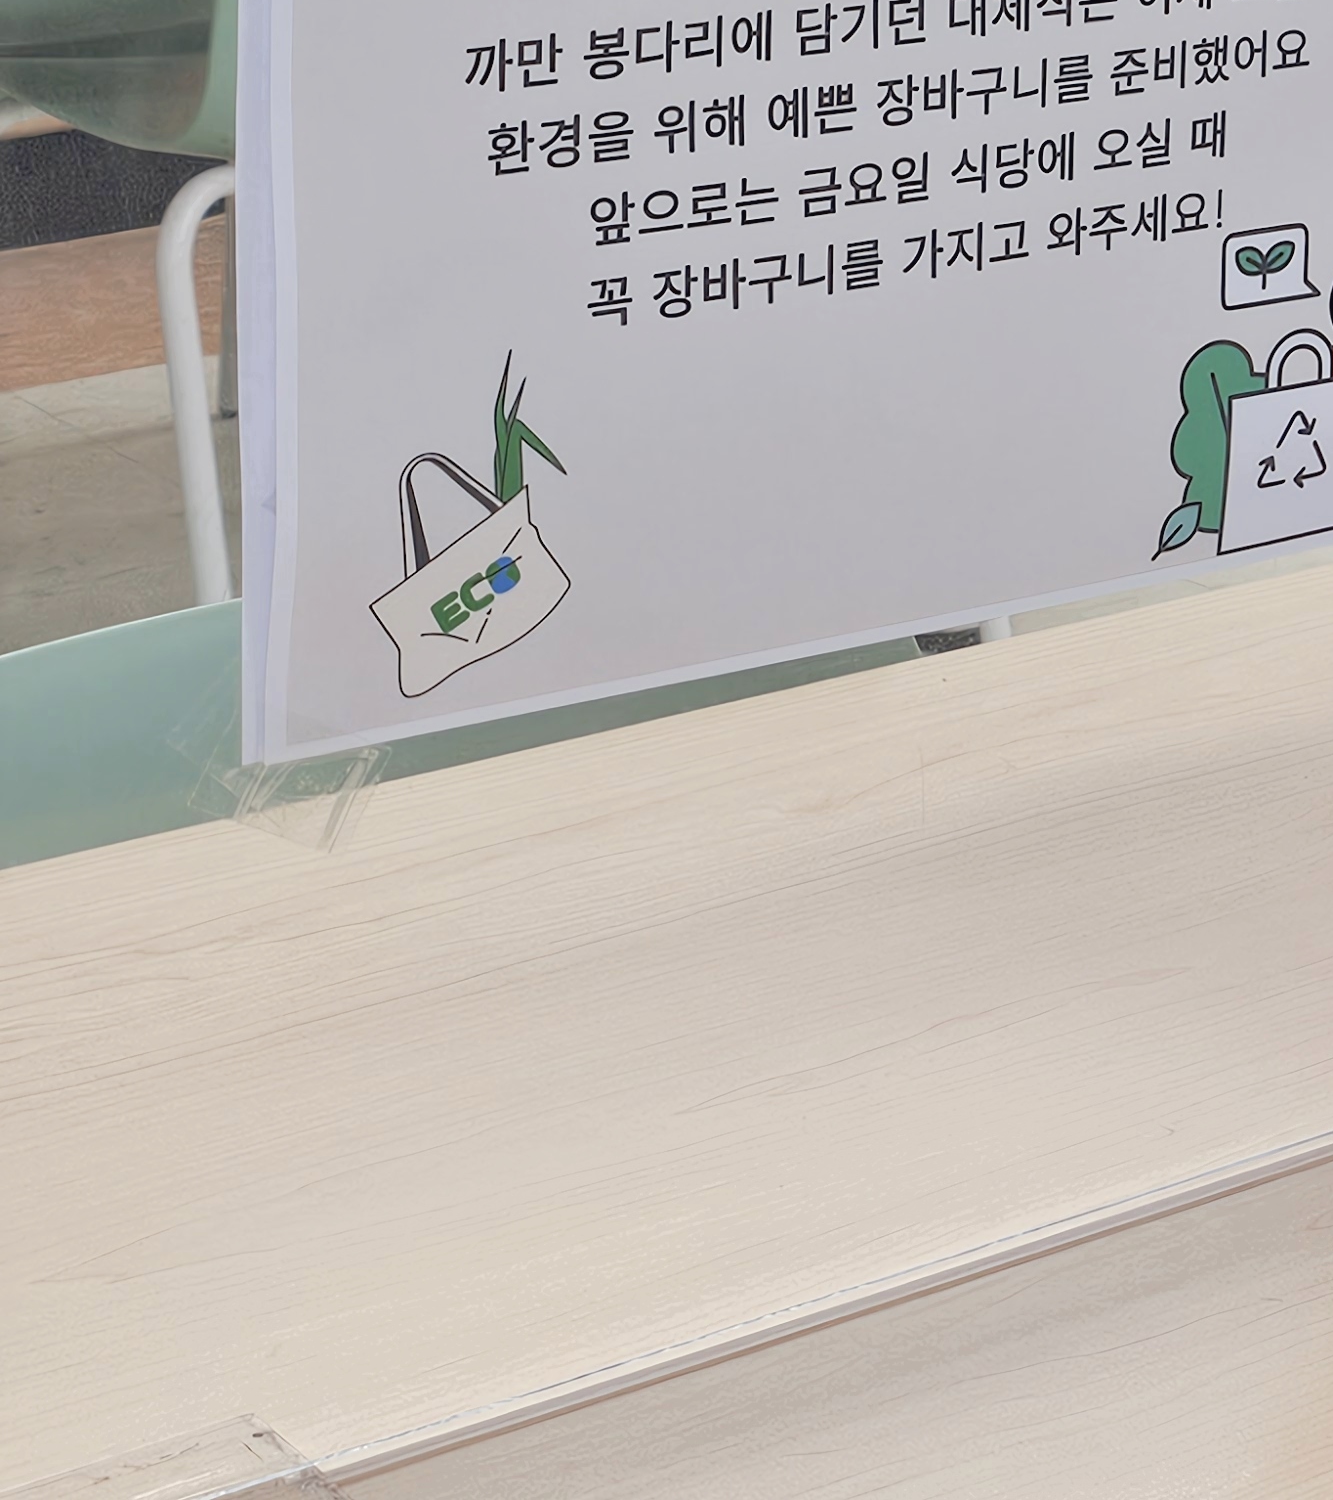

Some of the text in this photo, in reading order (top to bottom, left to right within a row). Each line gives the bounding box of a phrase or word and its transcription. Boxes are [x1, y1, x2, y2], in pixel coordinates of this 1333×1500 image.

[464, 32, 564, 93] 까만
[583, 9, 773, 80] 봉다리에
[487, 29, 1311, 177] 환경을 위해 예쁜 장바구니를 준비했어요
[589, 109, 1227, 247] 앞으로는 금요일 식당에 오실 때
[586, 188, 1224, 327] 꼭 장바구니를 가지고 와주세요!
[430, 556, 521, 634] ECO
